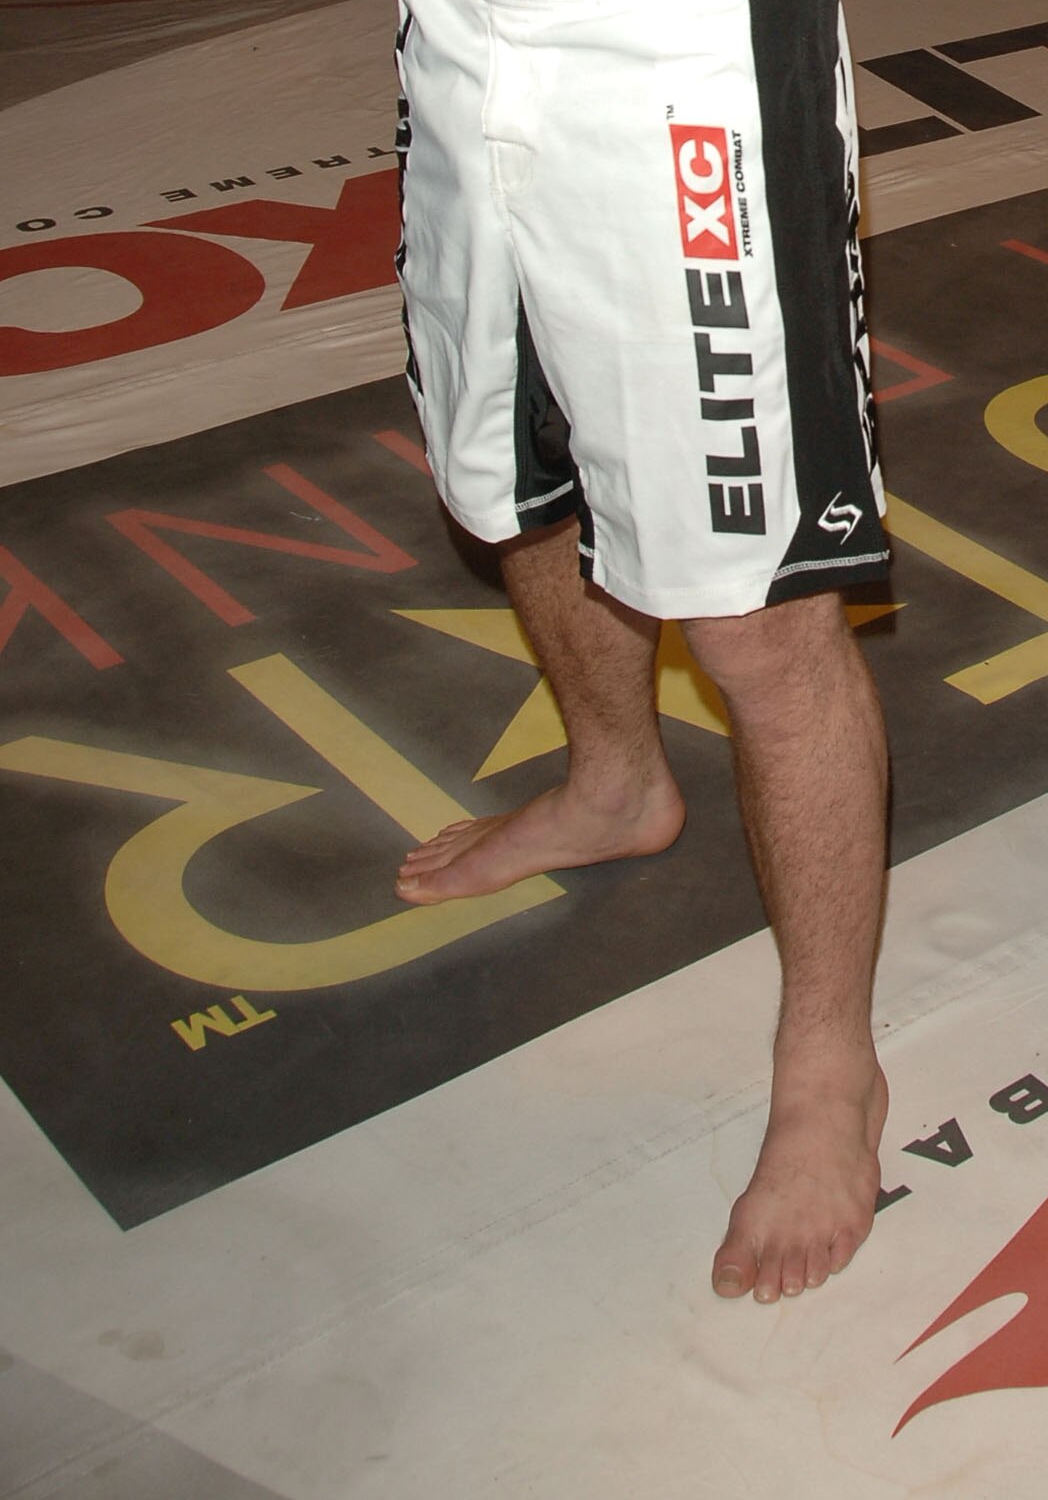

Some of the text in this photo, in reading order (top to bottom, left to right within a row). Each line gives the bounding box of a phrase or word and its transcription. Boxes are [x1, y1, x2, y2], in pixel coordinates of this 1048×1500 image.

[733, 130, 754, 257] XTREME COMBAT
[666, 104, 767, 536] ELITE XC TM
[170, 994, 278, 1052] TM
